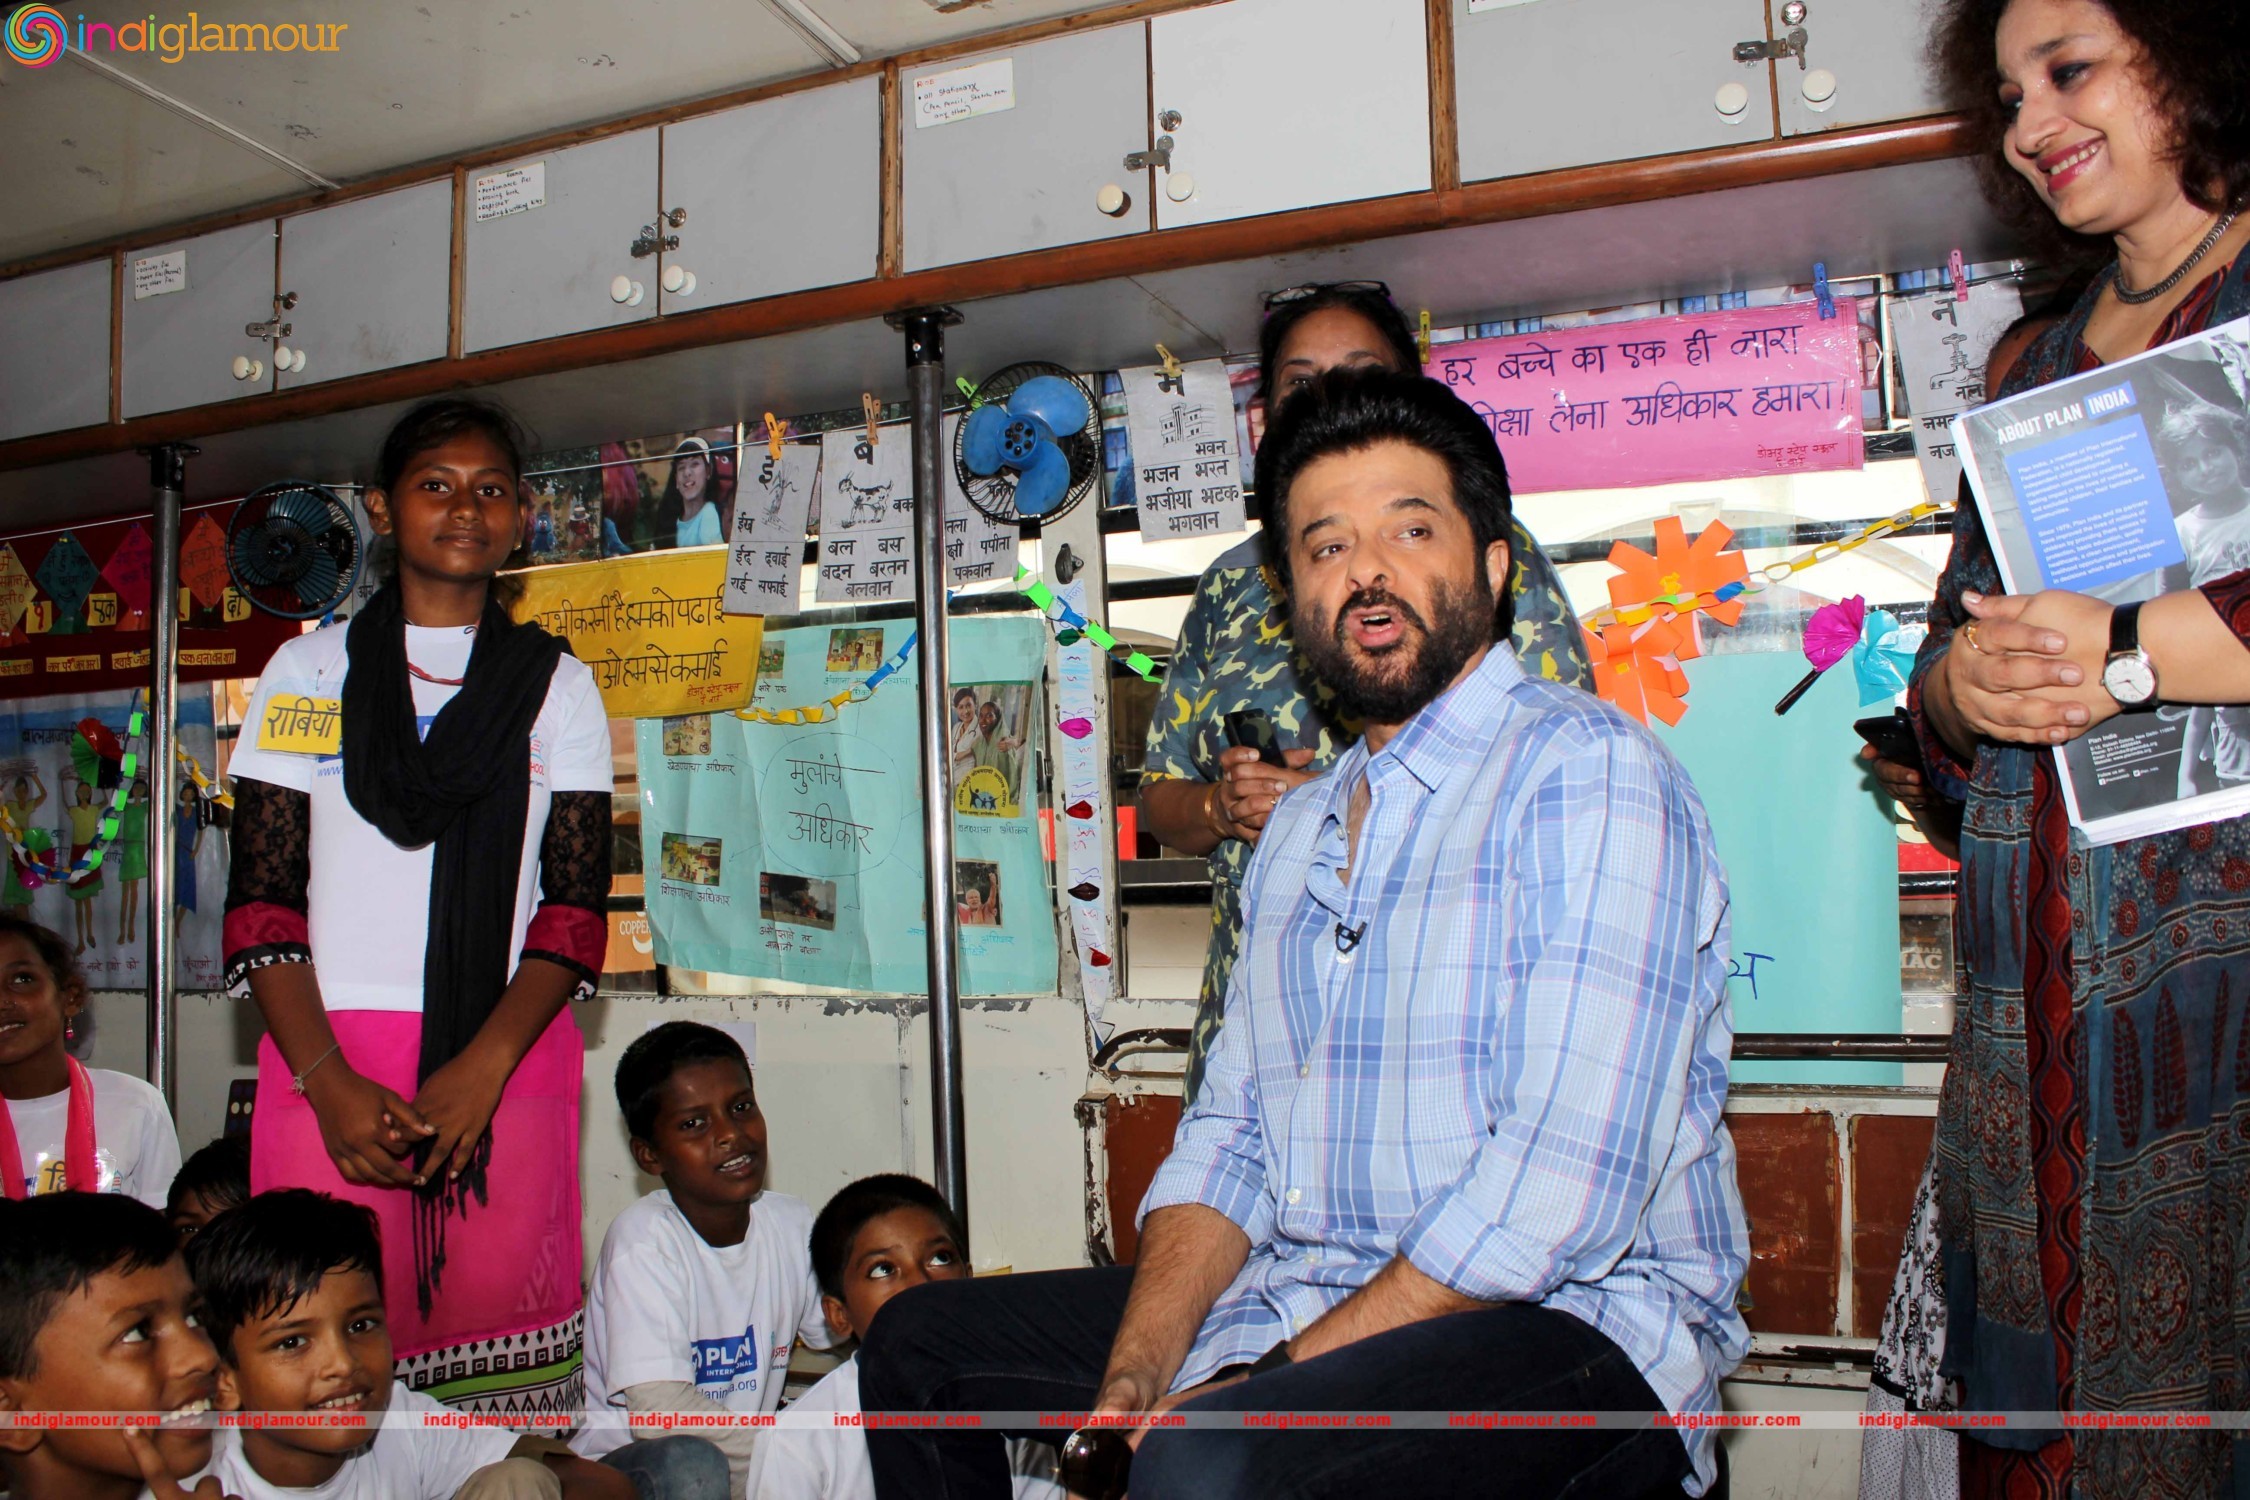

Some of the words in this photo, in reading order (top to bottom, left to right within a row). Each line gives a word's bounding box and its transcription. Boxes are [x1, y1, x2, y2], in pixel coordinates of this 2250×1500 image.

[1931, 297, 1958, 327] न
[1440, 357, 1477, 386] हर
[1498, 341, 1562, 379] बच्चे
[1572, 345, 1609, 374] का
[1618, 340, 1666, 368] एक
[1683, 328, 1717, 366] ही
[1730, 325, 1803, 359] नारा
[1955, 383, 1983, 400] नल
[1549, 392, 1609, 434] लेना
[1621, 381, 1742, 426] अधिकार
[1997, 415, 2042, 446] ABOUT
[2044, 402, 2084, 430] PLAN
[2087, 388, 2131, 415] INDIA
[1195, 440, 1227, 455] भवन
[1143, 465, 1180, 484] भजन
[1195, 459, 1229, 478] भरत
[892, 498, 914, 513] बक
[1145, 486, 1193, 511] भजीया
[1201, 484, 1239, 504] भटक
[1168, 511, 1220, 533] भगवान
[828, 539, 857, 556] बल
[877, 536, 905, 554] बस
[980, 533, 1011, 555] पपीता
[822, 564, 855, 582] बदन
[869, 559, 910, 578] बरतन
[953, 561, 994, 580] पकवान
[845, 580, 894, 598] बलवान
[91, 598, 116, 624] एक
[267, 696, 342, 739] राबियाँ
[2087, 736, 2101, 744] Plan
[2102, 732, 2117, 740] India
[785, 753, 886, 795] मुलांचे
[788, 802, 874, 855] अधिकार
[706, 1337, 751, 1367] PLAN
